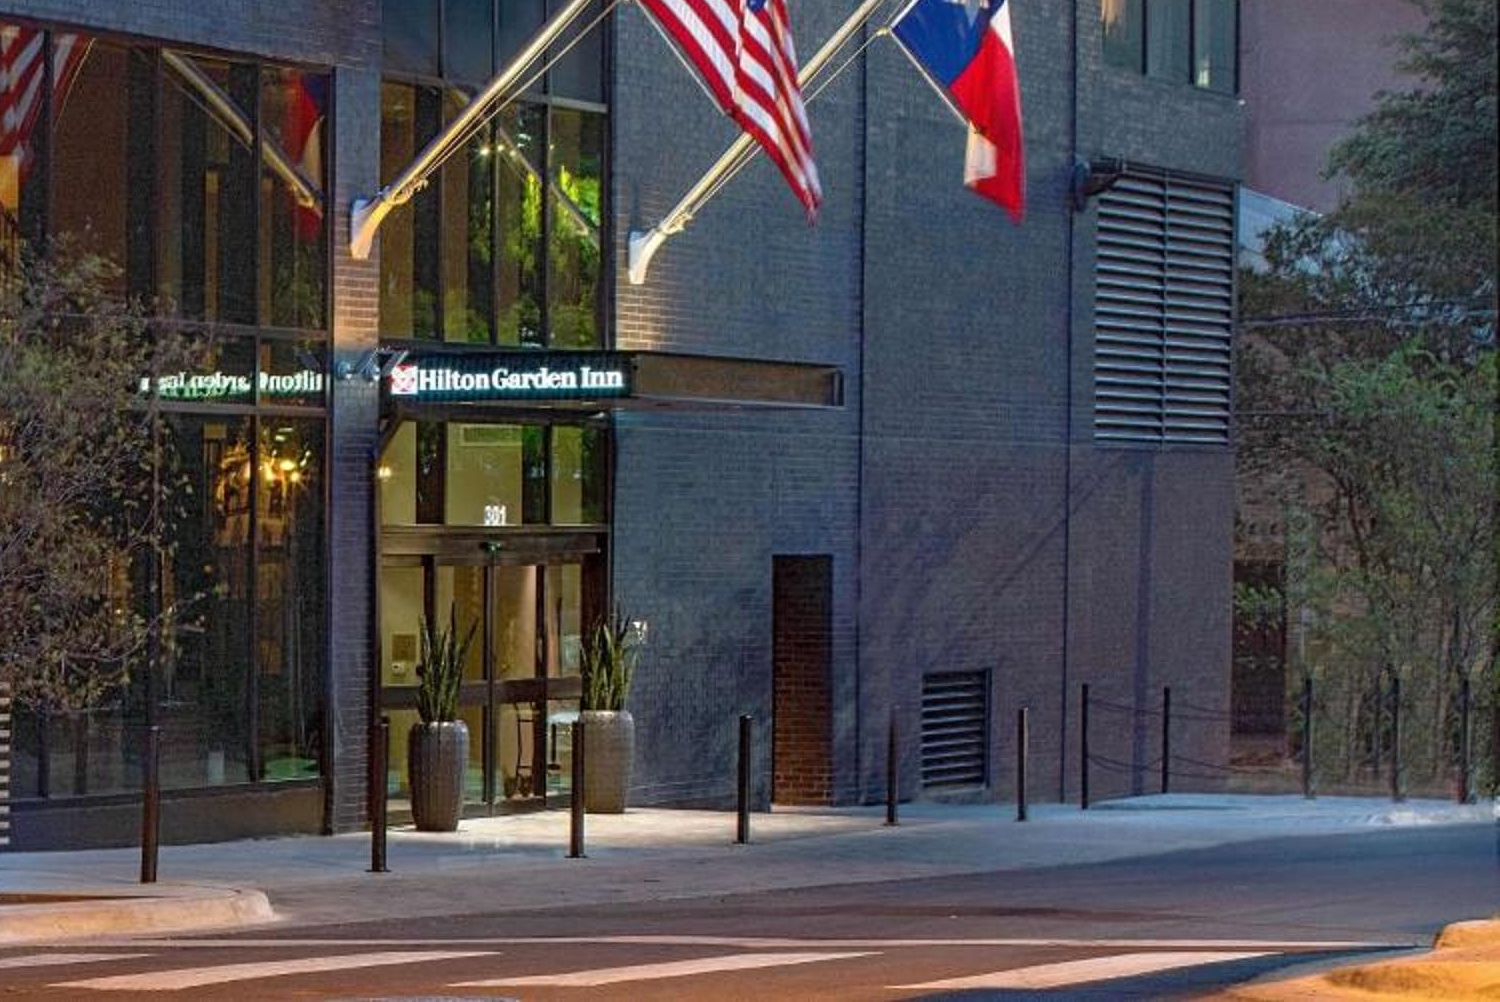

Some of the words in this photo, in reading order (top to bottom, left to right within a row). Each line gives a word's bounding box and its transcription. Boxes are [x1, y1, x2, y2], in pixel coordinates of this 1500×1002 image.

[418, 368, 491, 391] Hilton
[491, 367, 577, 390] Garden
[579, 365, 624, 389] Inn
